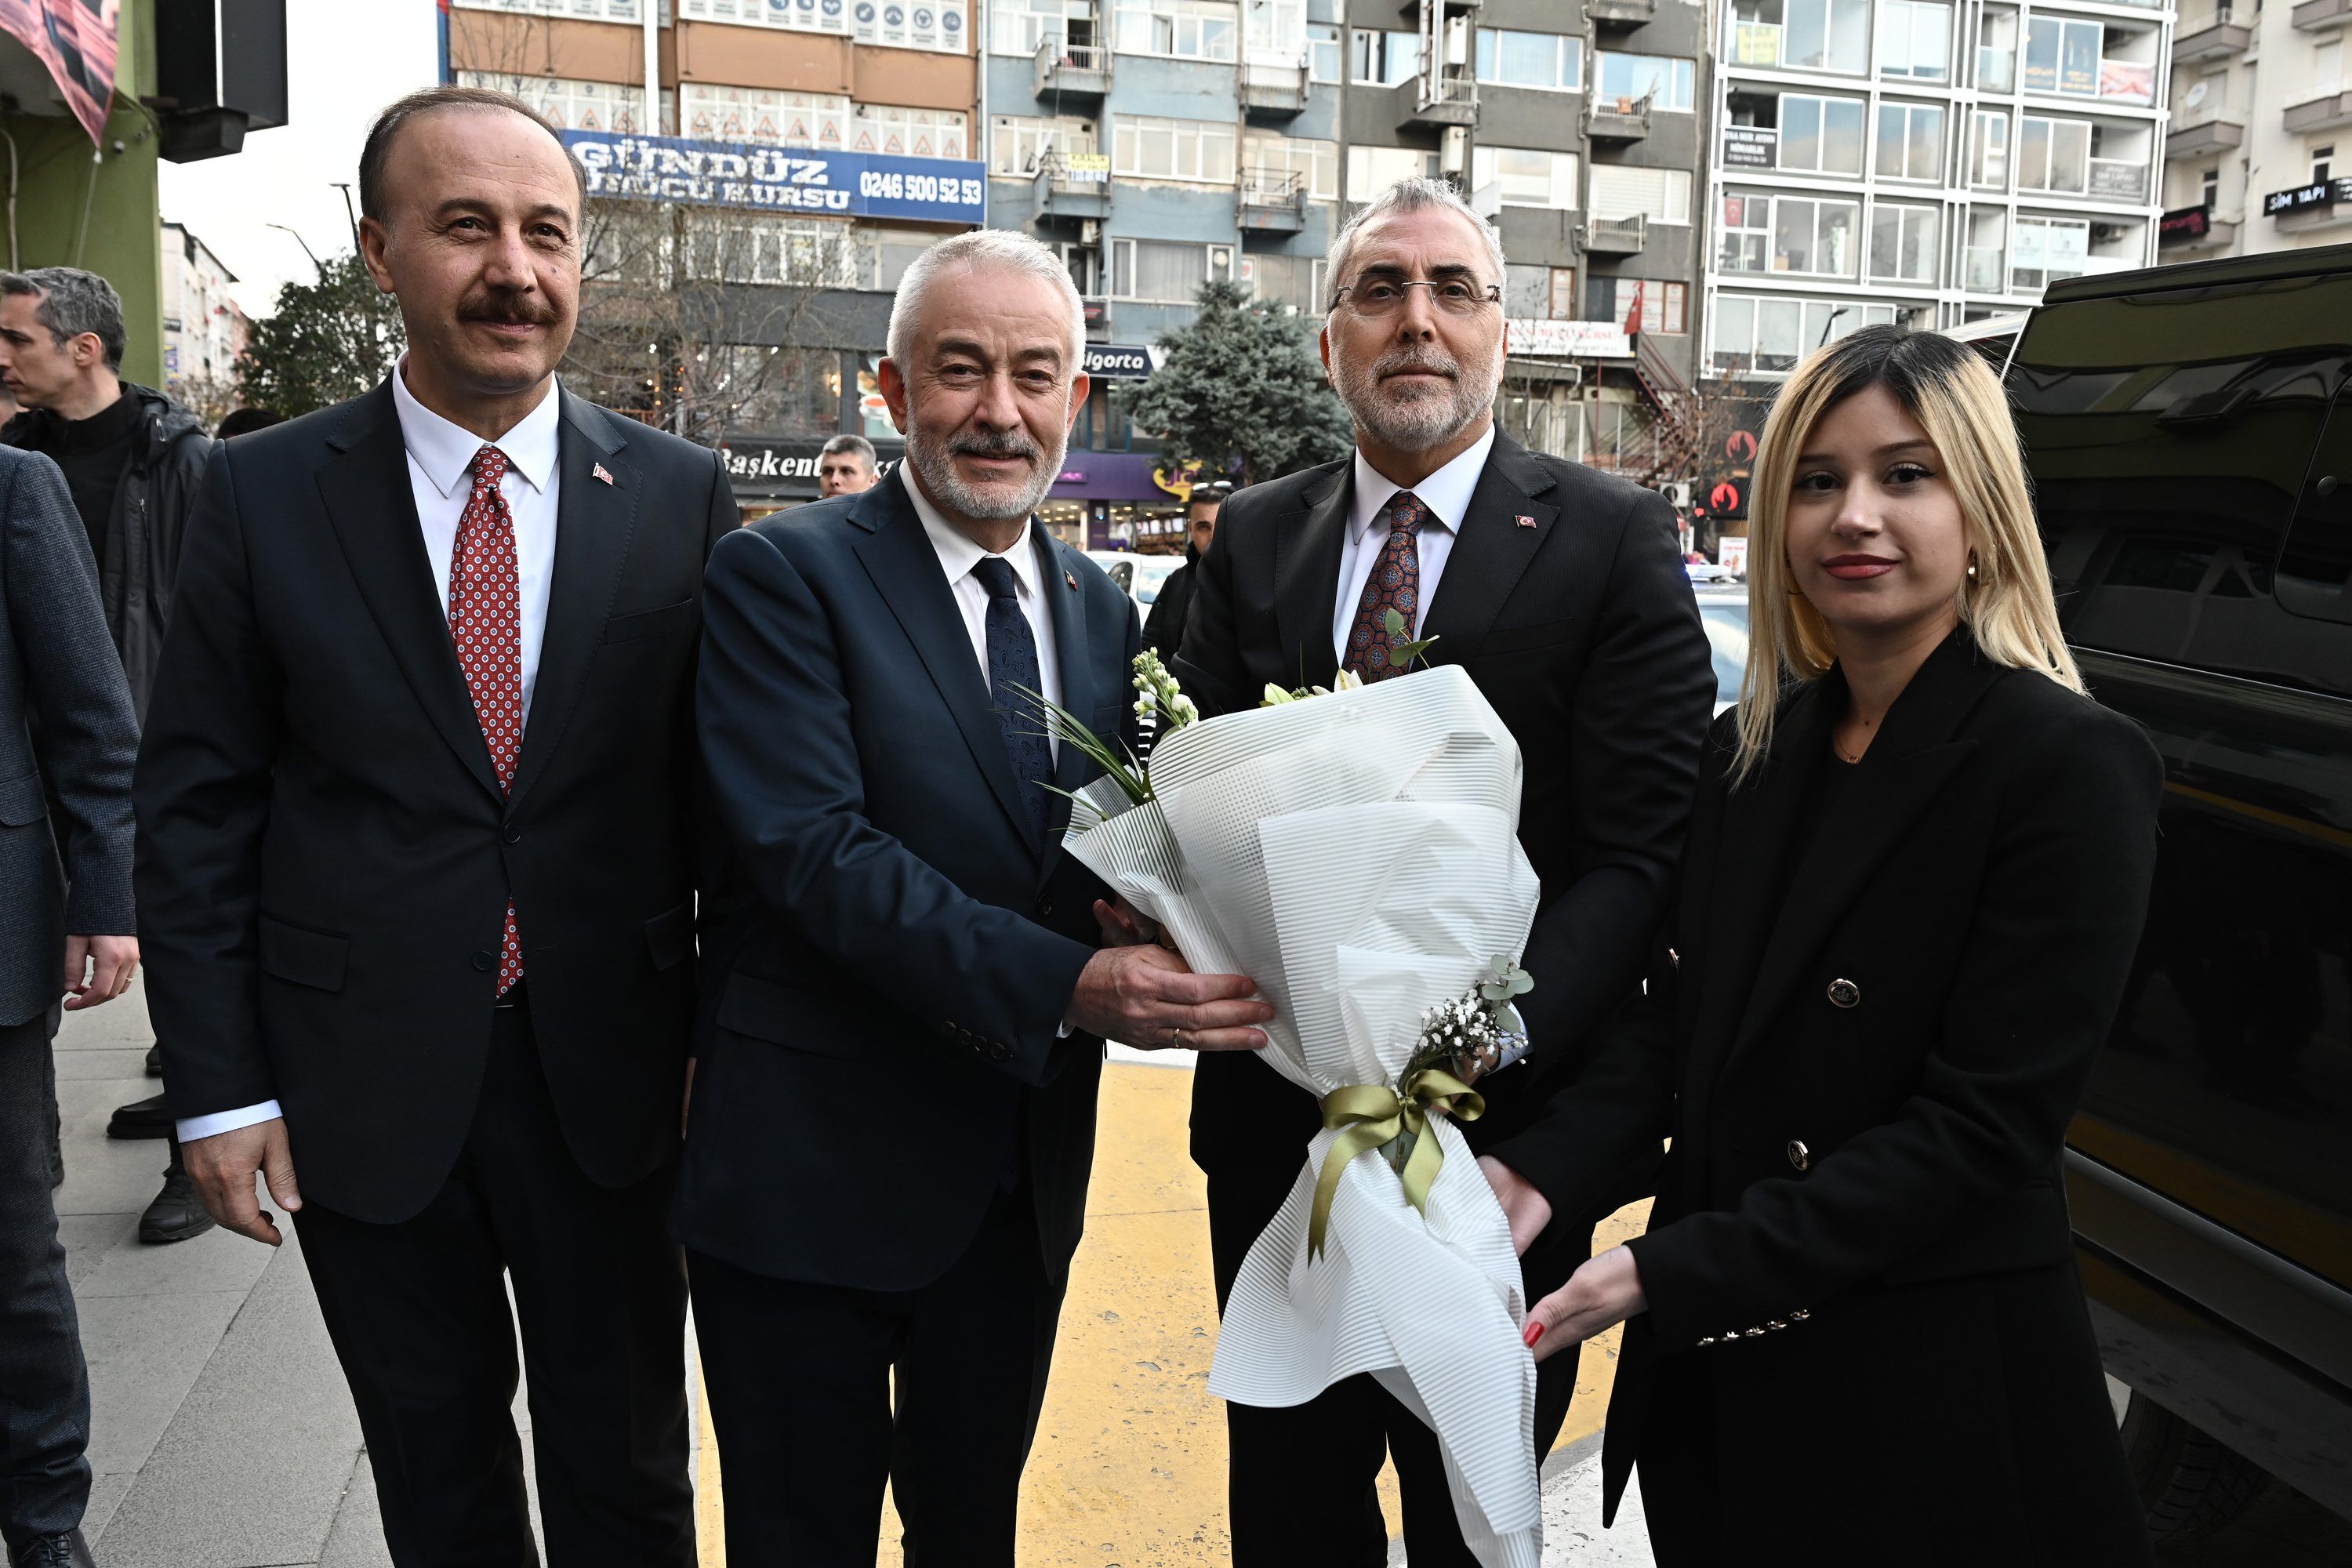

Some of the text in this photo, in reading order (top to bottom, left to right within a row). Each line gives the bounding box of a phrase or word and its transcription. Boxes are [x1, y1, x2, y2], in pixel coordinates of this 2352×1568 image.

[572, 138, 829, 185] GÜNDÜZ
[860, 170, 982, 205] 0246 500 52 53
[2297, 185, 2326, 205] YAPI
[1084, 350, 1145, 372] igorta
